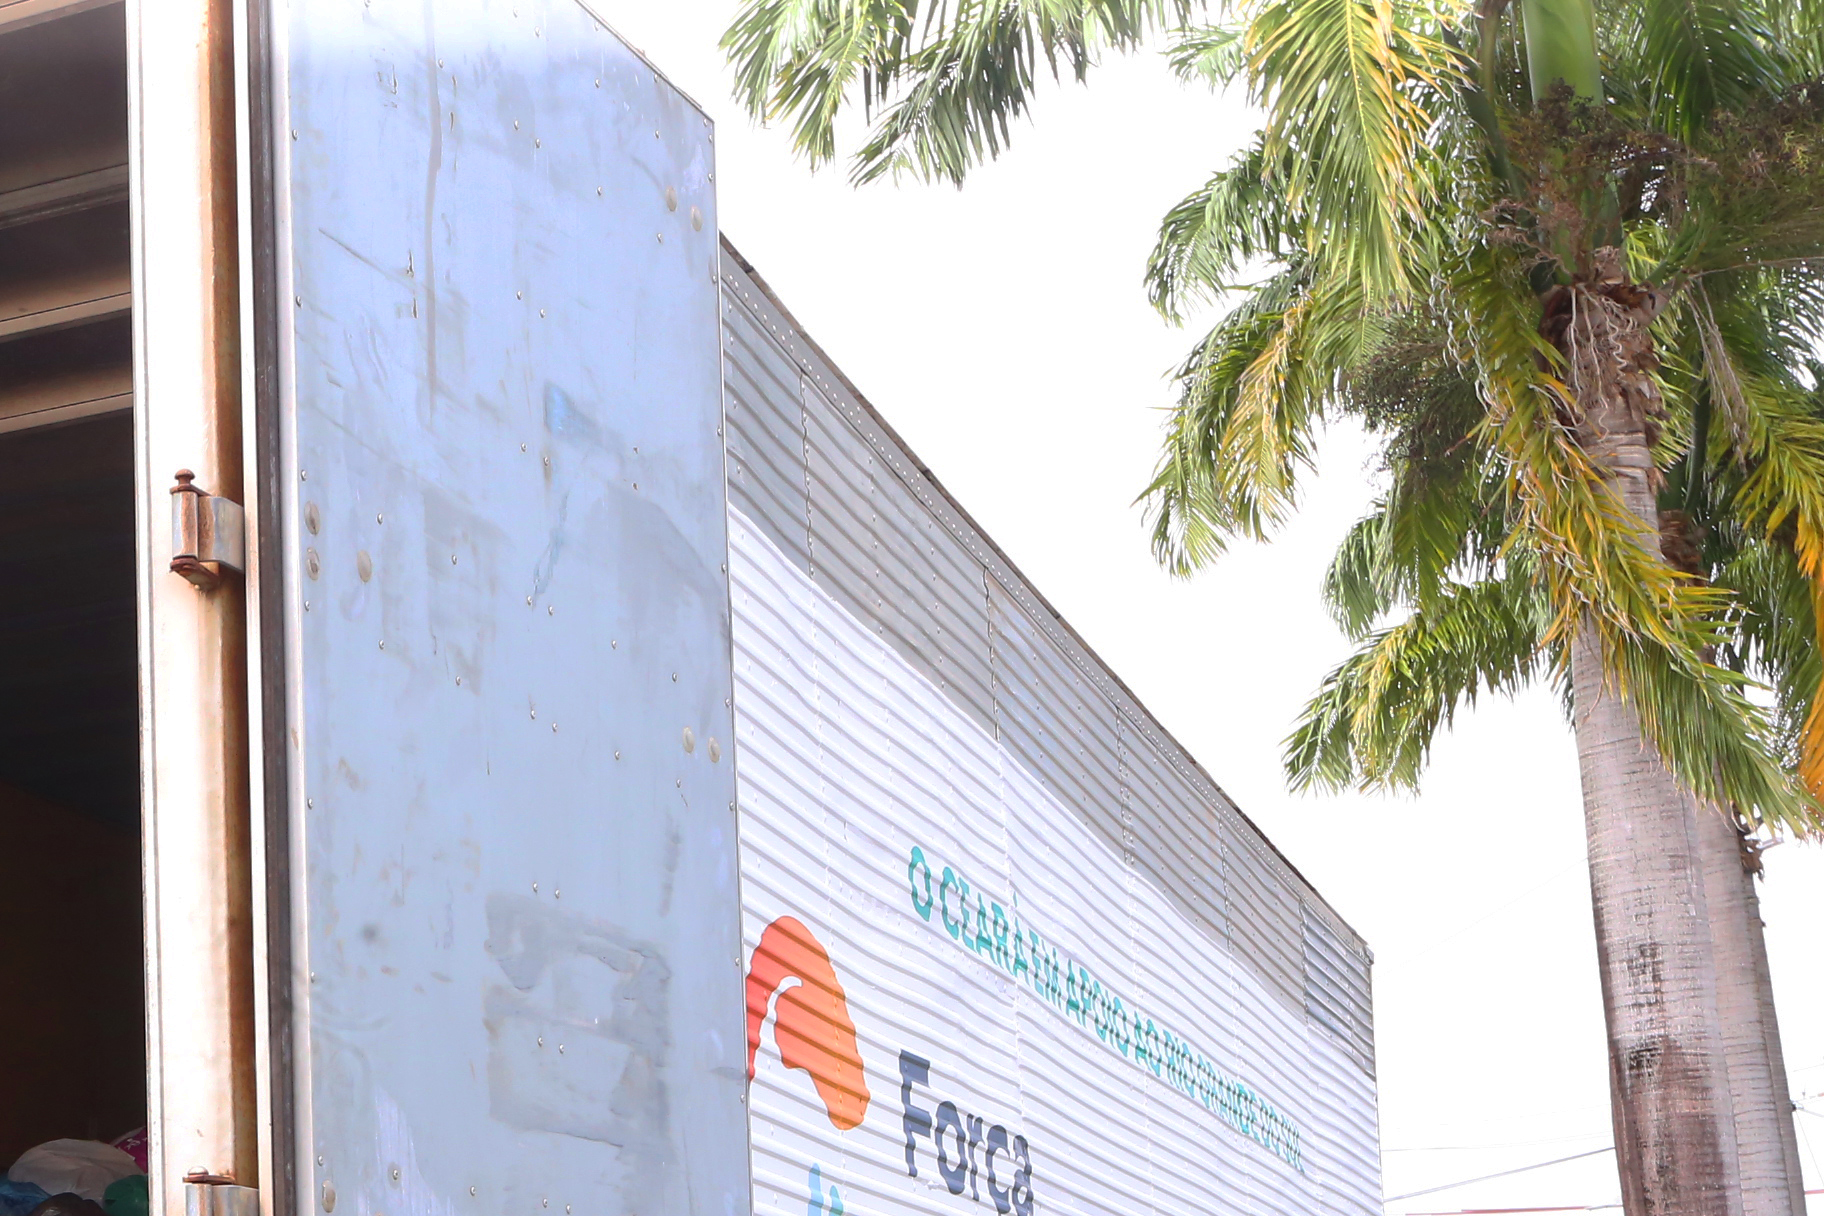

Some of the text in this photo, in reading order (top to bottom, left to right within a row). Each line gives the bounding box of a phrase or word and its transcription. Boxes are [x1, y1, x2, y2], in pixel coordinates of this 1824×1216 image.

[939, 866, 1028, 985] CEARÁ
[1029, 928, 1062, 1011] EM
[1066, 958, 1129, 1057] APOIO
[1134, 1010, 1161, 1077] AO
[1163, 1028, 1195, 1098] RIO
[1197, 1054, 1259, 1141] GRANDE
[1259, 1097, 1280, 1155] DO
[1281, 1114, 1305, 1173] SUL
